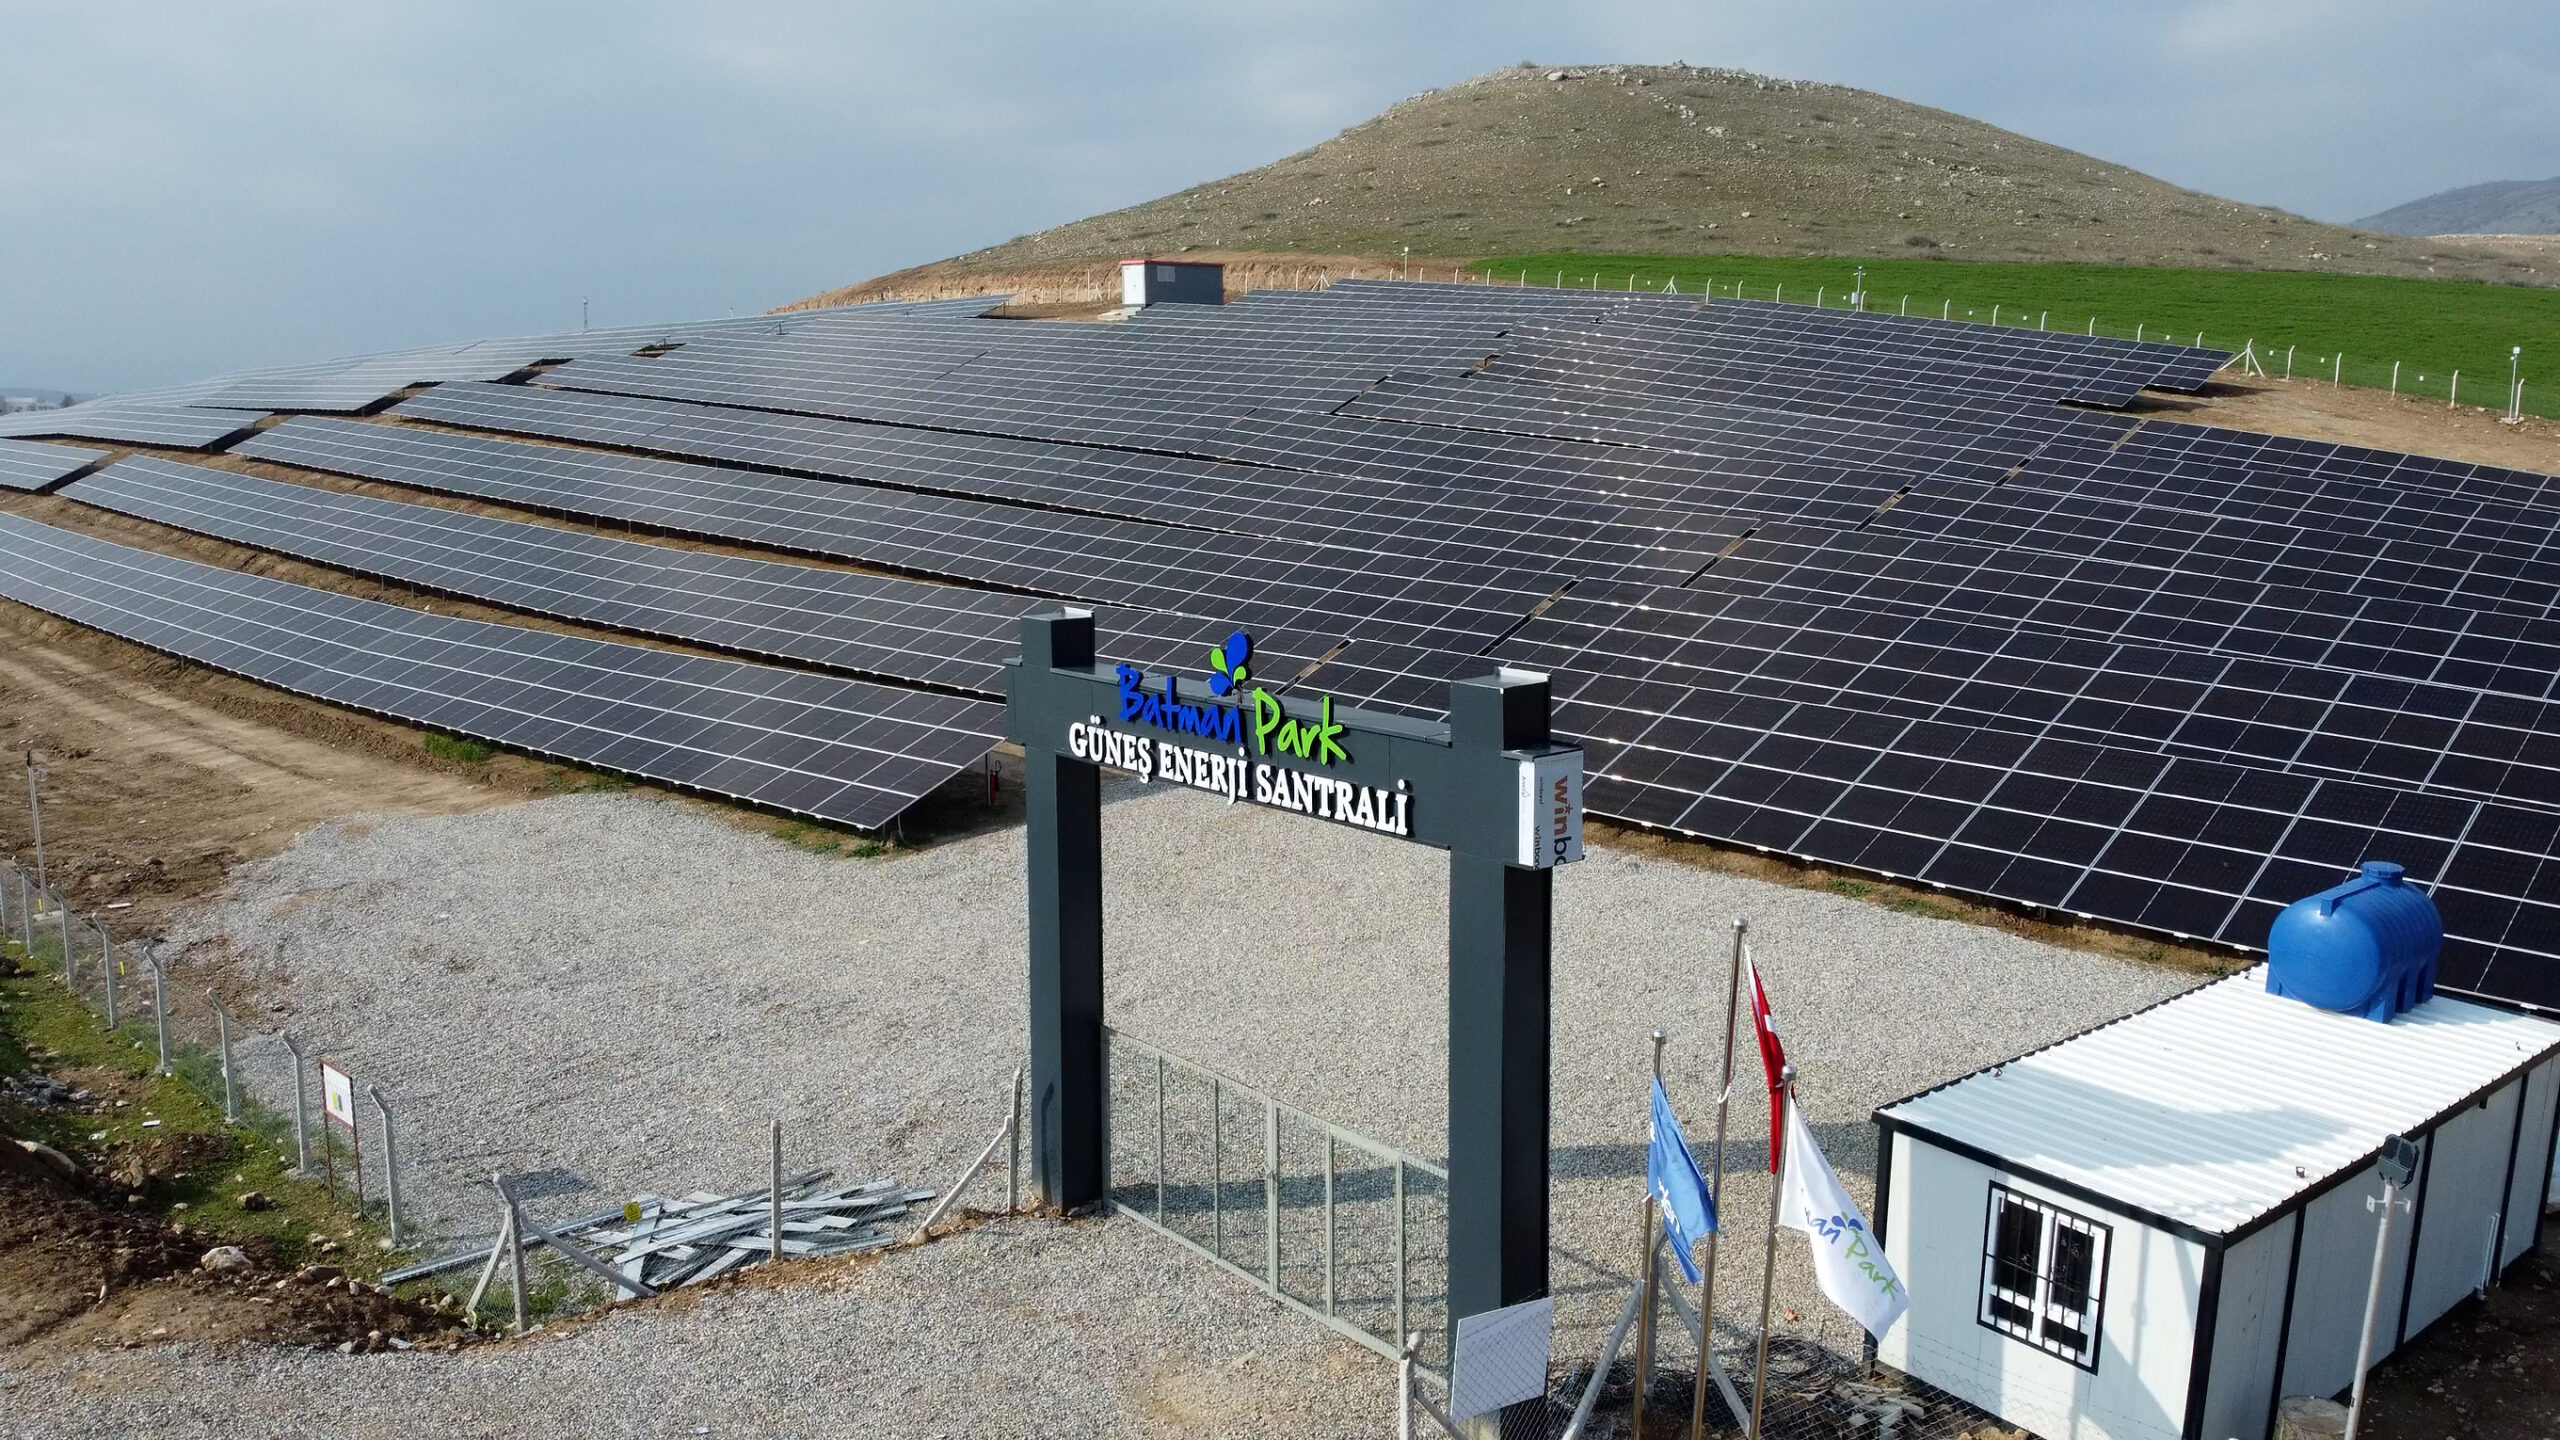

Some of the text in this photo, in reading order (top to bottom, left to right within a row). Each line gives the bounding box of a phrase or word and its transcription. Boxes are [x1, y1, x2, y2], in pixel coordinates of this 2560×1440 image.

[1115, 663, 1347, 765] Batman Park
[1068, 714, 1408, 836] GÜNEŞ ENERJİ SANTRALİ
[1844, 1227, 1899, 1302] Park
